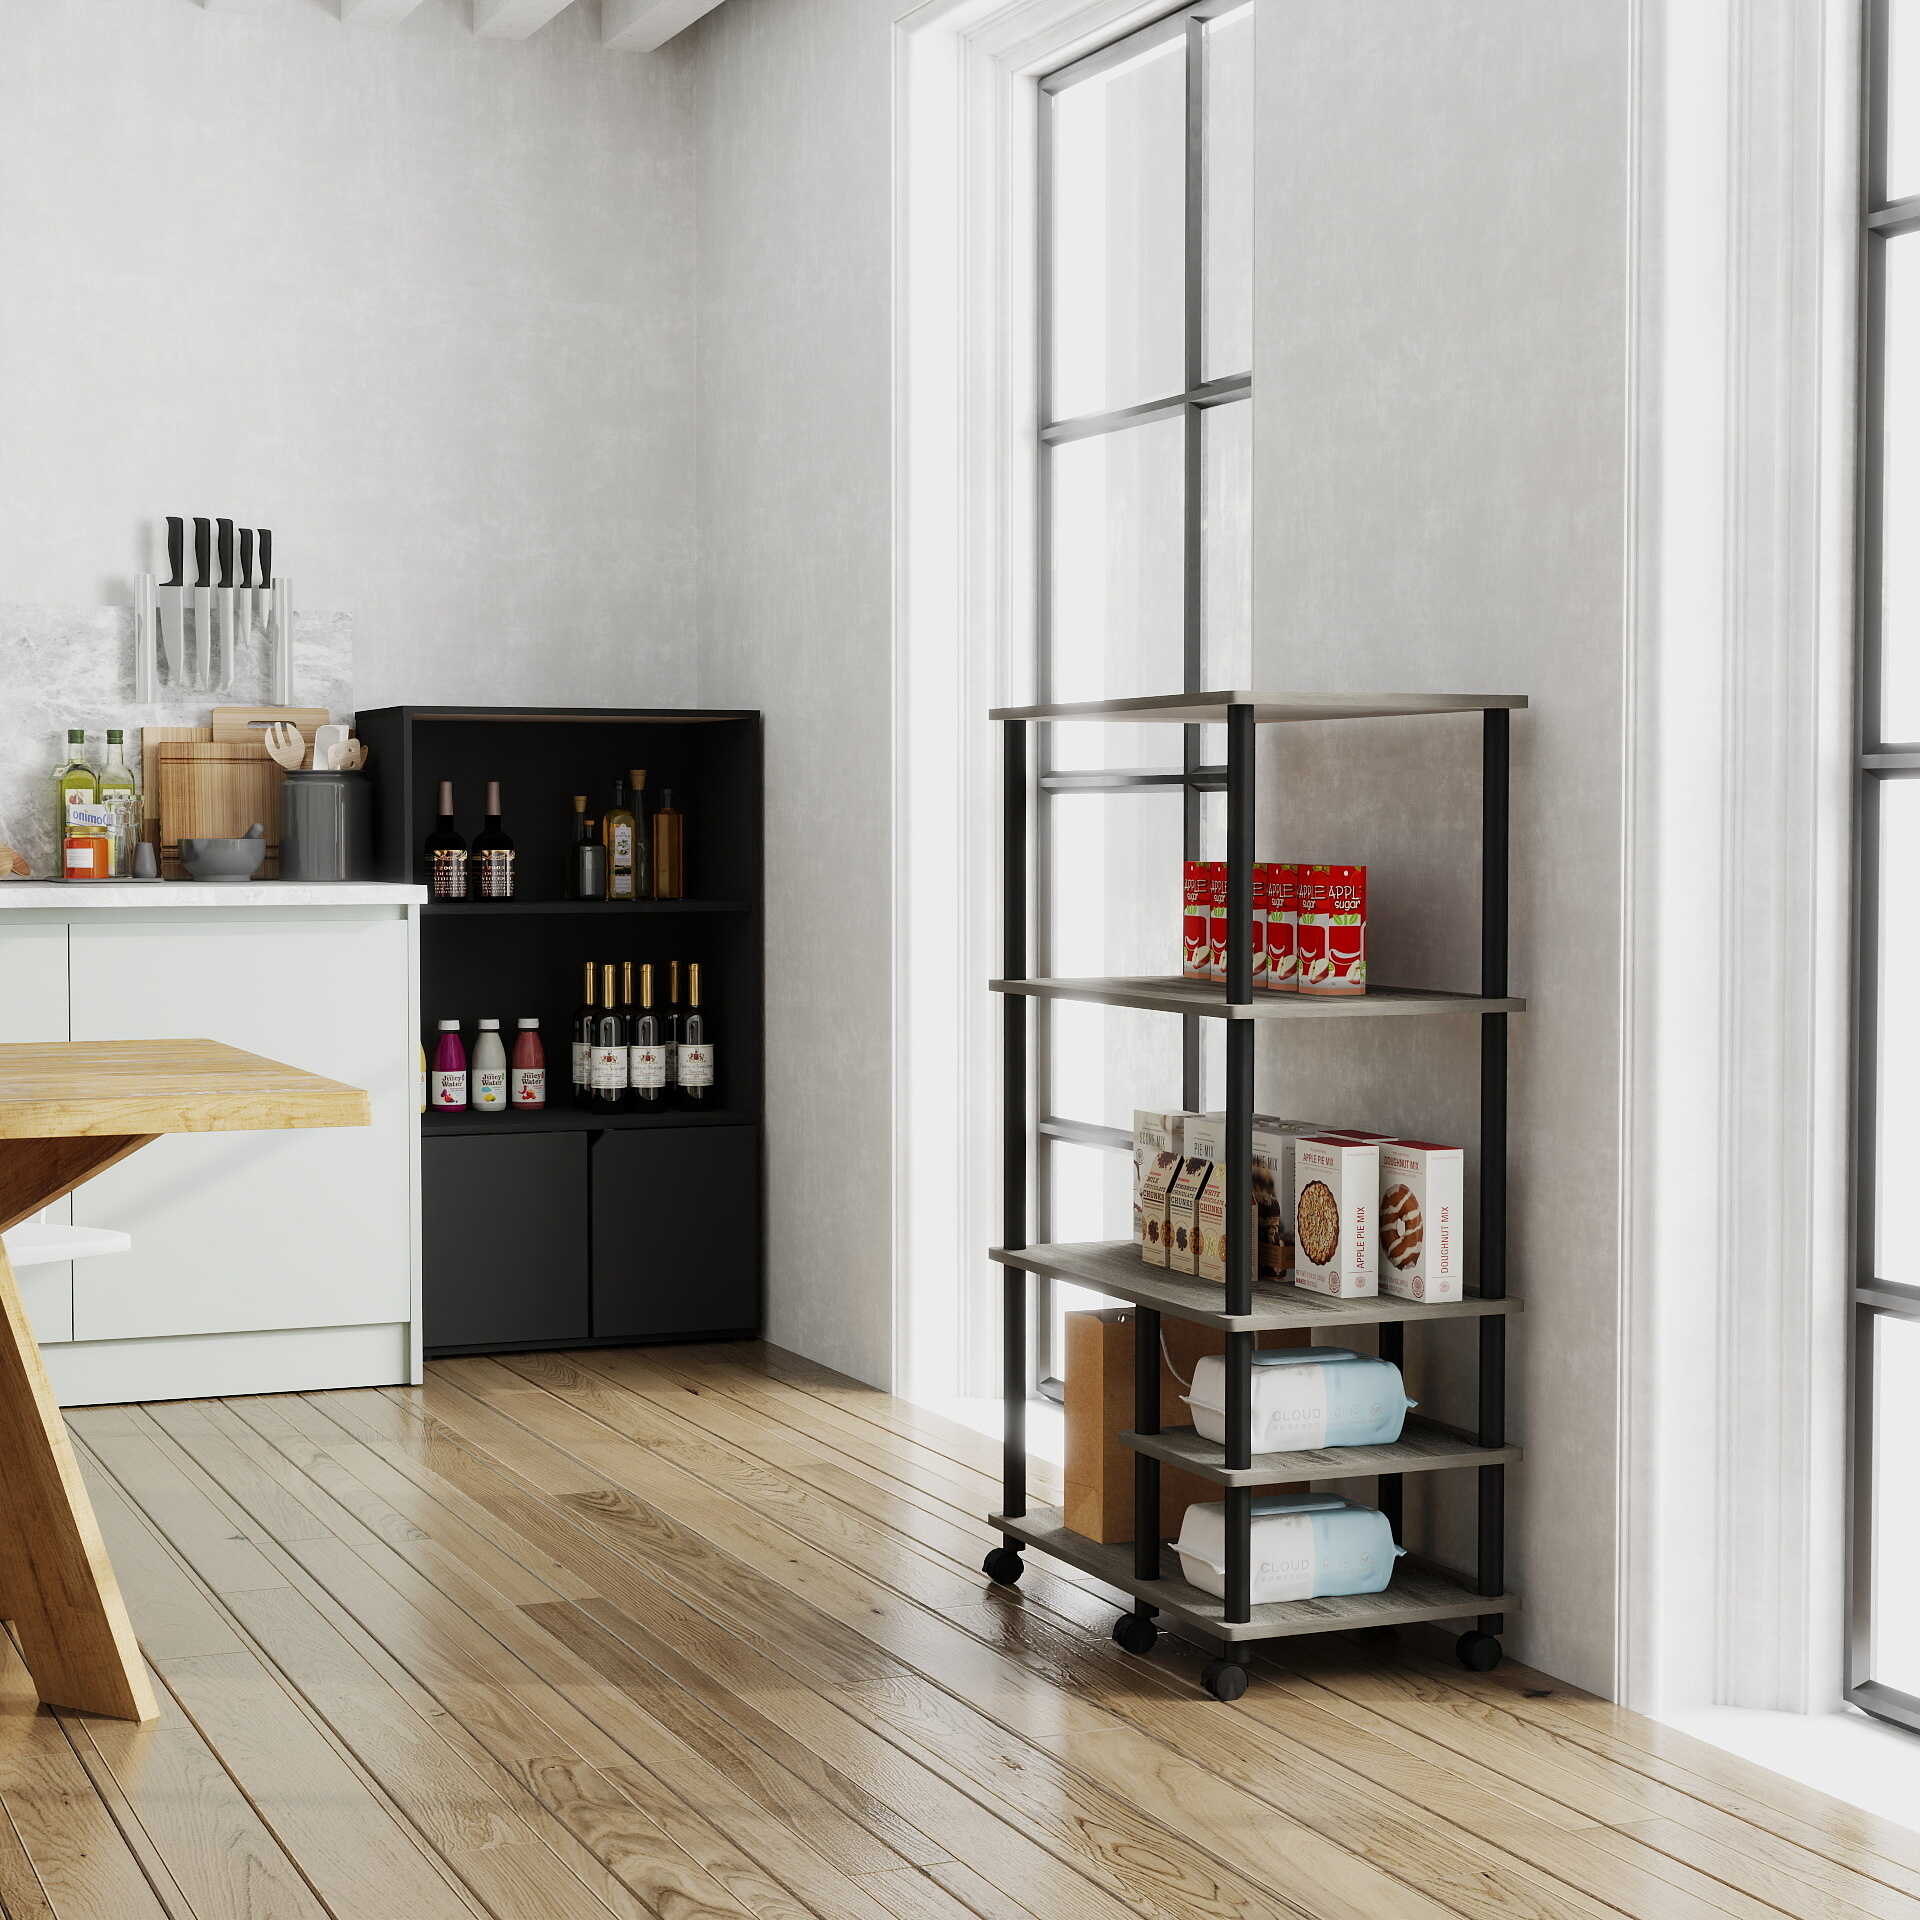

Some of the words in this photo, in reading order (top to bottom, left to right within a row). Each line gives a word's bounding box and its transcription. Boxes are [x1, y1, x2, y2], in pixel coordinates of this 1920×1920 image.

[1268, 883, 1296, 898] APPLE
[1298, 885, 1326, 900] APPLE
[1329, 885, 1361, 900] APPL
[1334, 900, 1361, 911] sugar
[1303, 1152, 1317, 1164] APPLE
[1317, 1155, 1326, 1165] PIE
[1326, 1157, 1334, 1166] MIX
[1410, 1160, 1420, 1170] MIX
[1143, 1190, 1164, 1200] CHUNKS
[1171, 1195, 1193, 1208] CHUNKS
[1200, 1203, 1223, 1214] CHUNKS
[1356, 1206, 1365, 1223] MIX
[1441, 1206, 1449, 1222] MIX
[1356, 1225, 1365, 1241] PIE
[1356, 1241, 1365, 1269] APPLE
[1441, 1226, 1449, 1273] DOUGHNUT
[1272, 1407, 1320, 1421] CLOUD
[1260, 1559, 1310, 1574] CLOUD
